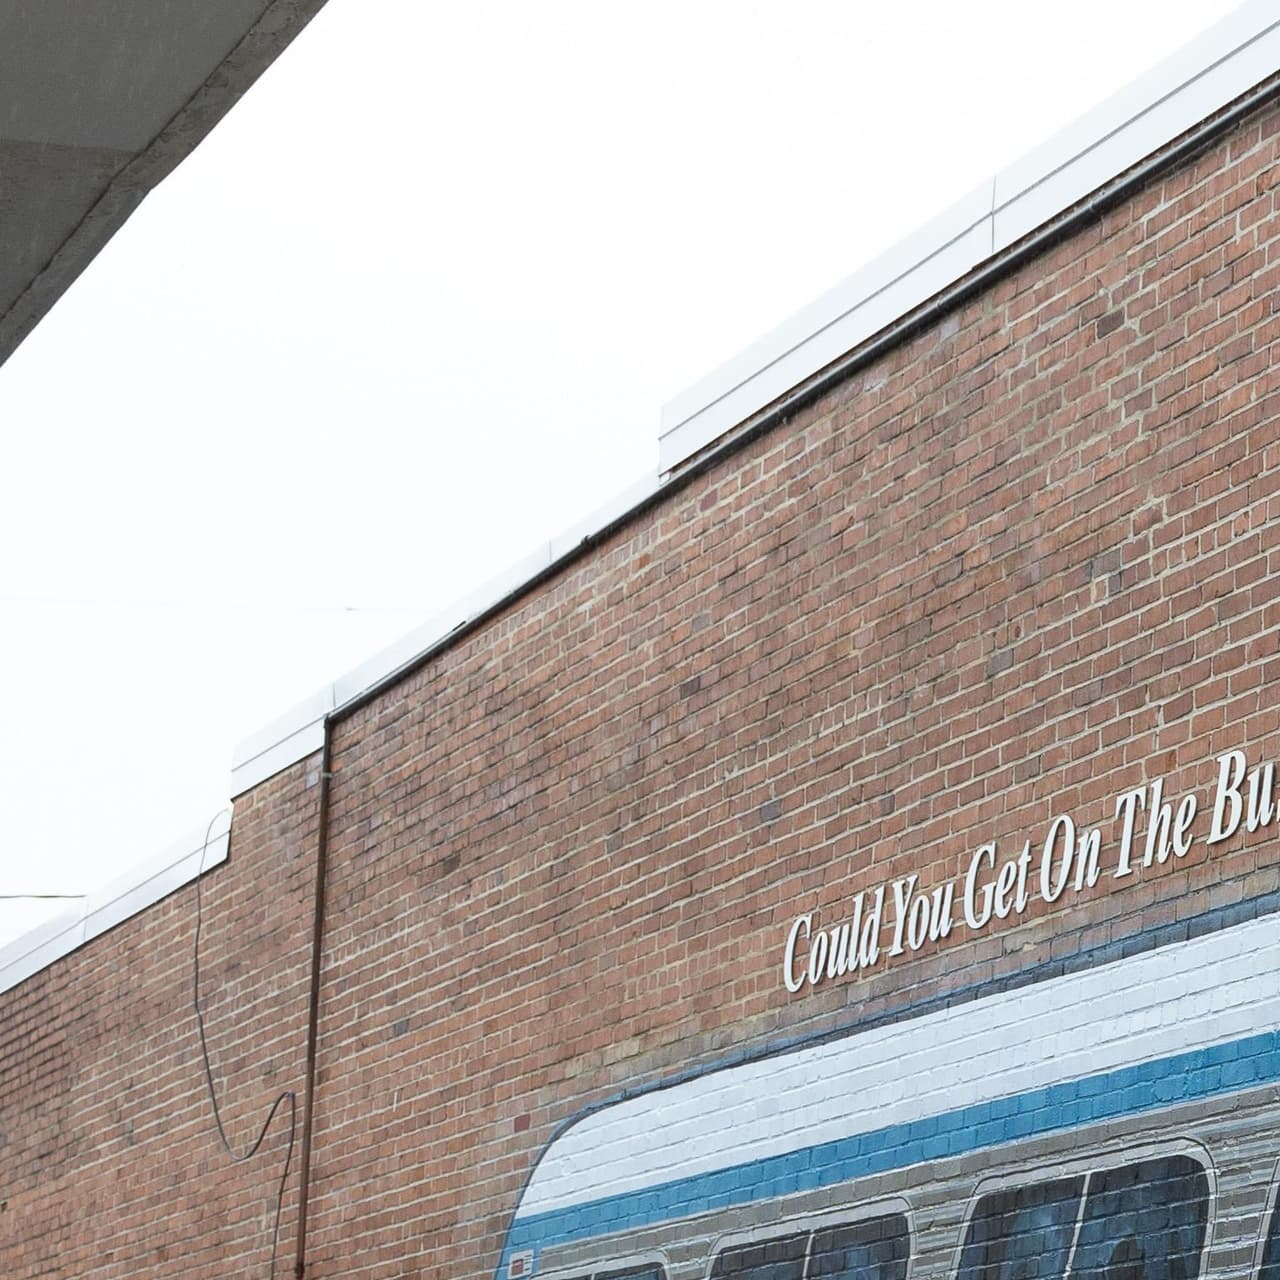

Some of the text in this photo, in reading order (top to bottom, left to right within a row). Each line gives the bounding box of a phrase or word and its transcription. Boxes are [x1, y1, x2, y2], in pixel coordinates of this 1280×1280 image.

[783, 886, 884, 994] Could
[888, 874, 953, 958] You
[963, 840, 1032, 930] Get
[1039, 814, 1101, 903] On
[1113, 777, 1198, 879] The
